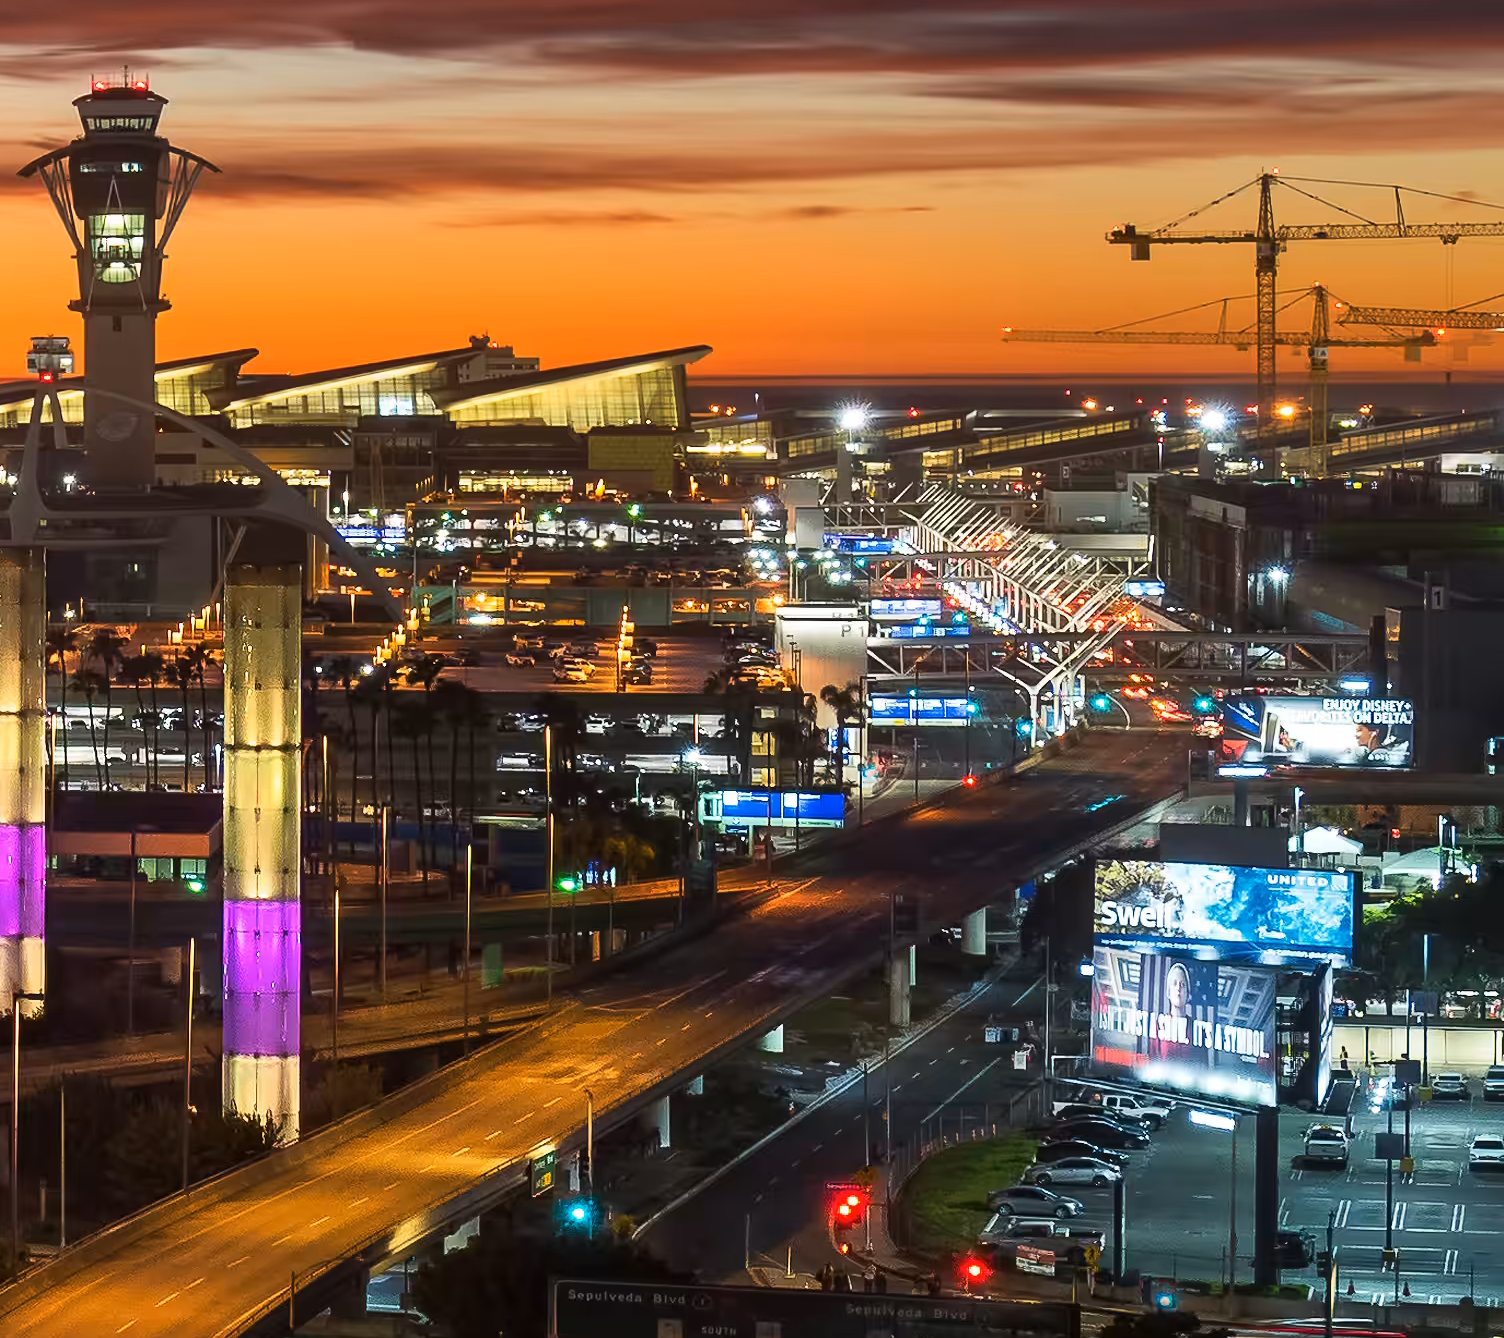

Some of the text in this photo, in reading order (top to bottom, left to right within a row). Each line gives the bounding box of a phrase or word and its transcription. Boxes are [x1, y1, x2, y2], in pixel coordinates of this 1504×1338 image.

[841, 624, 851, 637] P
[1323, 698, 1412, 712] ENJOY DISNEY+
[1353, 711, 1371, 724] ON
[1373, 711, 1412, 725] DELTA.
[1267, 874, 1329, 887] UNITED
[1149, 1012, 1157, 1038] A
[1193, 1019, 1213, 1049] IT'S
[1214, 1023, 1223, 1051] A
[568, 1288, 642, 1303] Sepulveda
[653, 1293, 686, 1305] Blvd
[845, 1302, 968, 1320] Sepulveda Blvd
[701, 1326, 737, 1336] SOUTH
